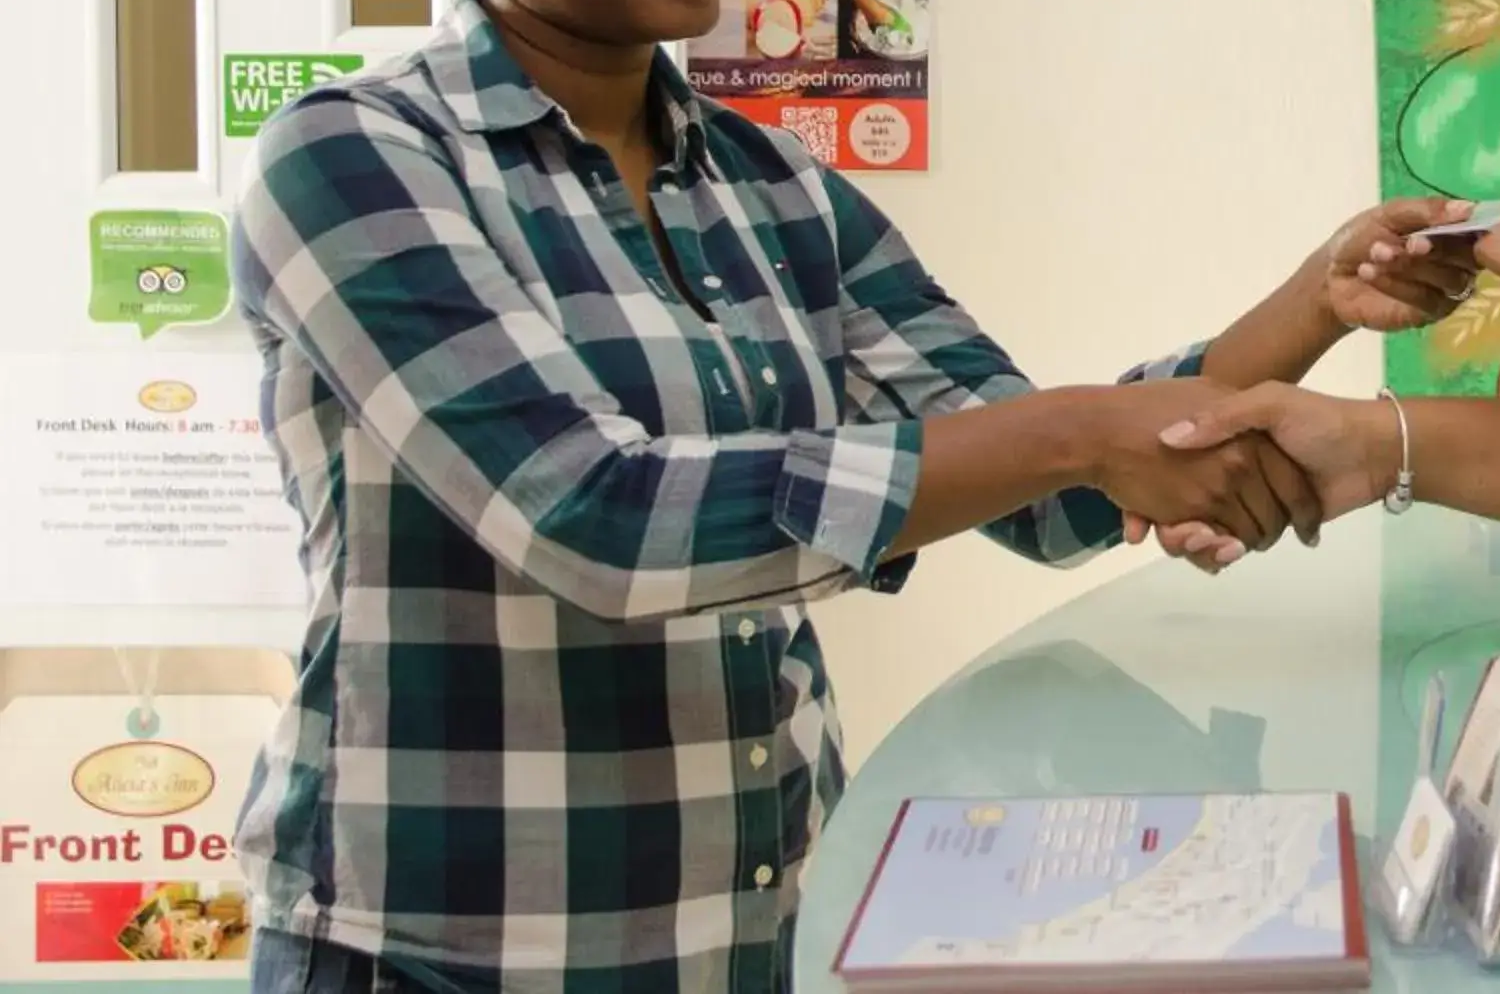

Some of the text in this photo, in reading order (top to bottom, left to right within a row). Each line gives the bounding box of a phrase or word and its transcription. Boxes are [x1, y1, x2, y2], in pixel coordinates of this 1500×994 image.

[230, 61, 304, 87] FREE
[687, 70, 726, 91] que
[730, 68, 744, 87] &
[749, 69, 828, 90] magical
[833, 70, 911, 88] moment
[36, 418, 76, 432] Front
[81, 418, 118, 432] Desk
[190, 421, 215, 433] am
[0, 823, 237, 863] Front De
